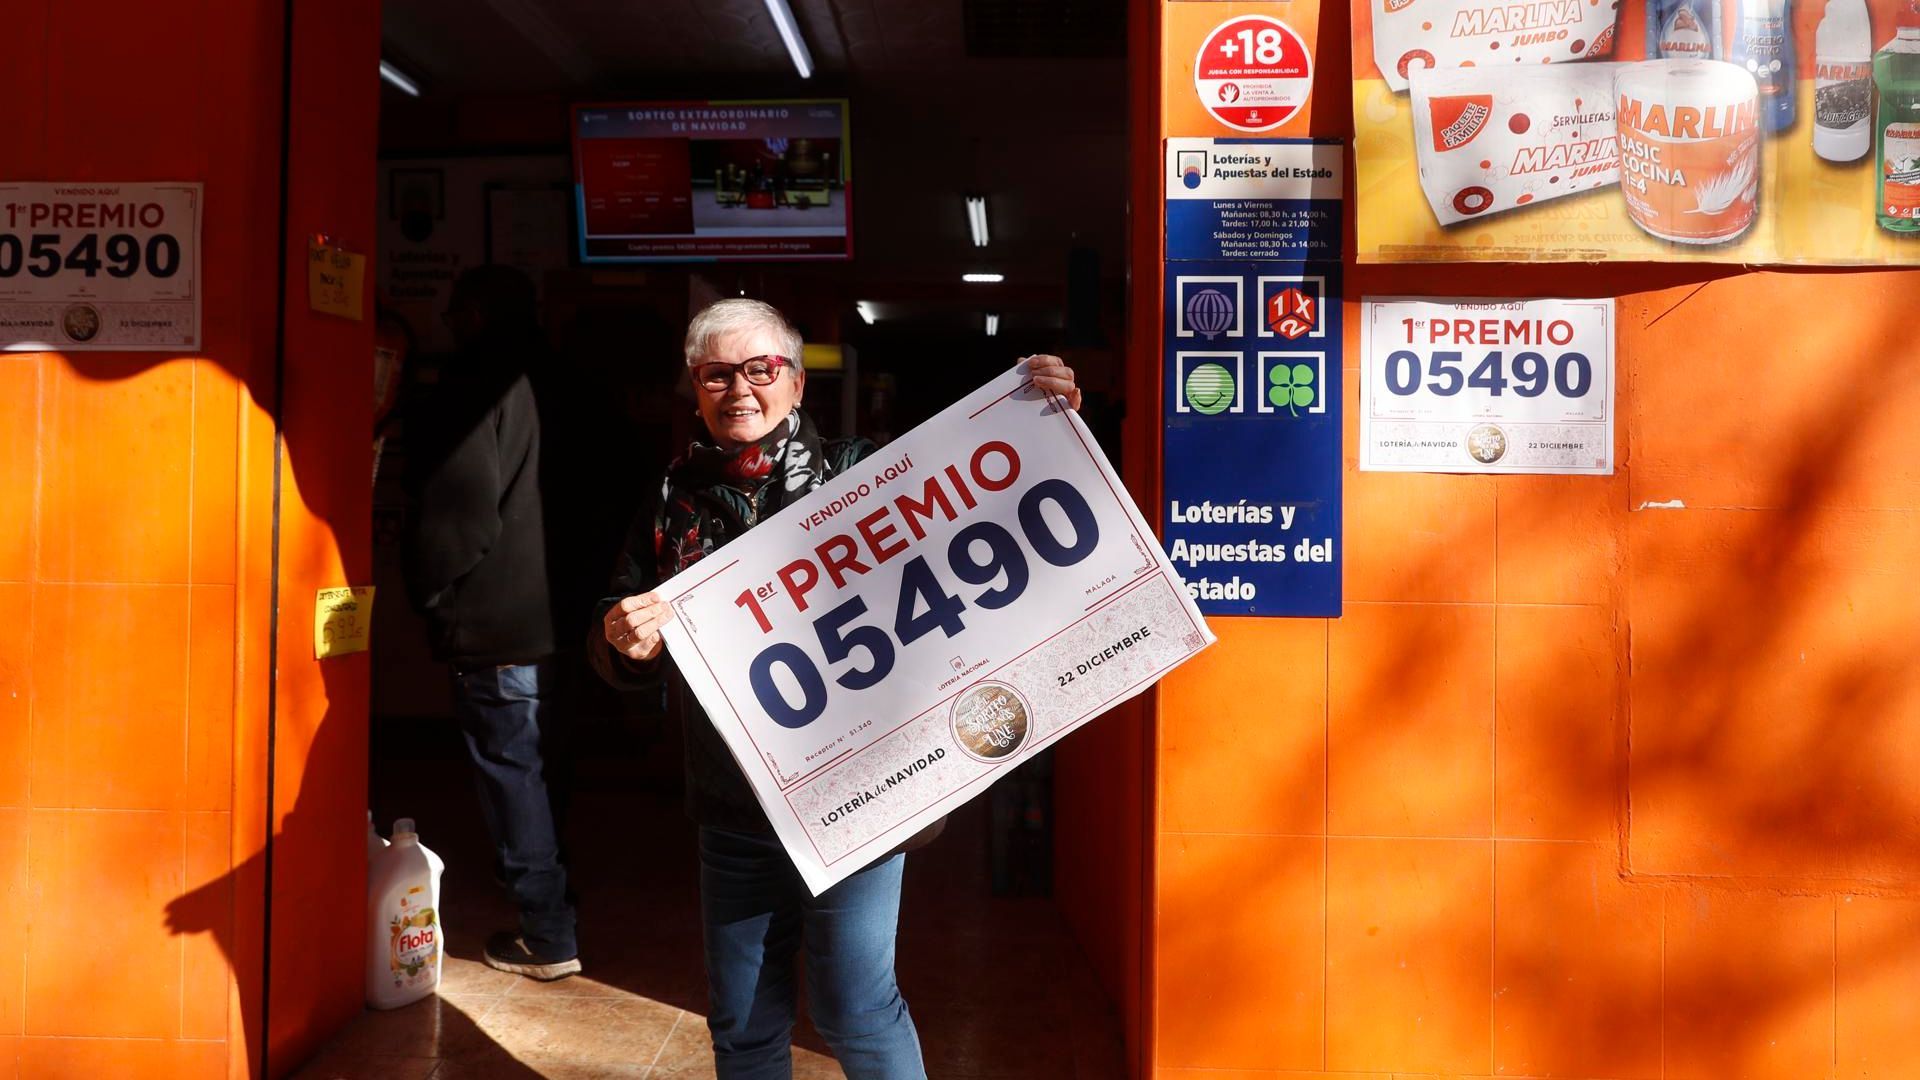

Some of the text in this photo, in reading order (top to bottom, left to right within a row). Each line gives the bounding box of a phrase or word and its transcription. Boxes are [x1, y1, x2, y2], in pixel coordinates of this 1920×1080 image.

[1450, 0, 1582, 38] MARLINA
[1220, 28, 1283, 65] +18
[1511, 29, 1569, 47] JUMBO
[628, 109, 789, 121] SORTEO EXTRAORDINARIO
[672, 121, 747, 132] DE NAVIDAD
[1442, 103, 1476, 138] PAQUETE
[1445, 106, 1487, 147] FAMILIAR
[1213, 154, 1272, 167] Loterías y
[1620, 133, 1661, 163] BASIC
[1213, 167, 1333, 180] Apuestas del Estado
[1622, 152, 1686, 186] COCINA
[1624, 170, 1647, 194] 1=4
[54, 188, 96, 196] VENDIDO
[1213, 201, 1236, 209] Lunes
[1244, 201, 1273, 209] Viernes
[30, 203, 164, 228] PREMIO
[1221, 210, 1258, 218] Mañanas:
[1259, 211, 1281, 219] 08,30
[1298, 211, 1319, 219] 14,00
[1221, 220, 1249, 228] Tardes:
[1250, 220, 1271, 228] 17,00
[1272, 220, 1281, 228] h.
[1288, 220, 1309, 228] 21,00
[1213, 231, 1246, 239] Sábados
[1254, 231, 1293, 240] Domingos
[1221, 240, 1258, 248] Mañanas:
[1259, 241, 1281, 249] 08,30
[1298, 241, 1319, 249] 14,00
[0, 233, 180, 278] 05490
[1453, 302, 1497, 311] VENDIDO
[1429, 319, 1574, 346] PREMIO
[1384, 350, 1592, 398] 05490
[1379, 440, 1412, 448] LOTERÍA
[799, 453, 914, 532] VENDIDO AQUÍ
[776, 441, 1021, 613] PREMIO
[1171, 499, 1296, 531] Loterías y
[1170, 537, 1333, 568] Apuestas del
[1085, 574, 1117, 596] MALAGA
[749, 478, 1100, 729] 05490
[1058, 626, 1151, 687] 22 DICIEMBRE
[938, 659, 990, 691] LOTERÍA NACIONAL
[965, 695, 1008, 736] SORTEO
[805, 741, 836, 762] Receptor
[849, 720, 873, 737] 51.340
[982, 722, 1016, 748] UNE
[821, 791, 876, 827] LOTERÍA
[885, 747, 946, 788] NAVIDAD
[399, 930, 433, 953] Flota
